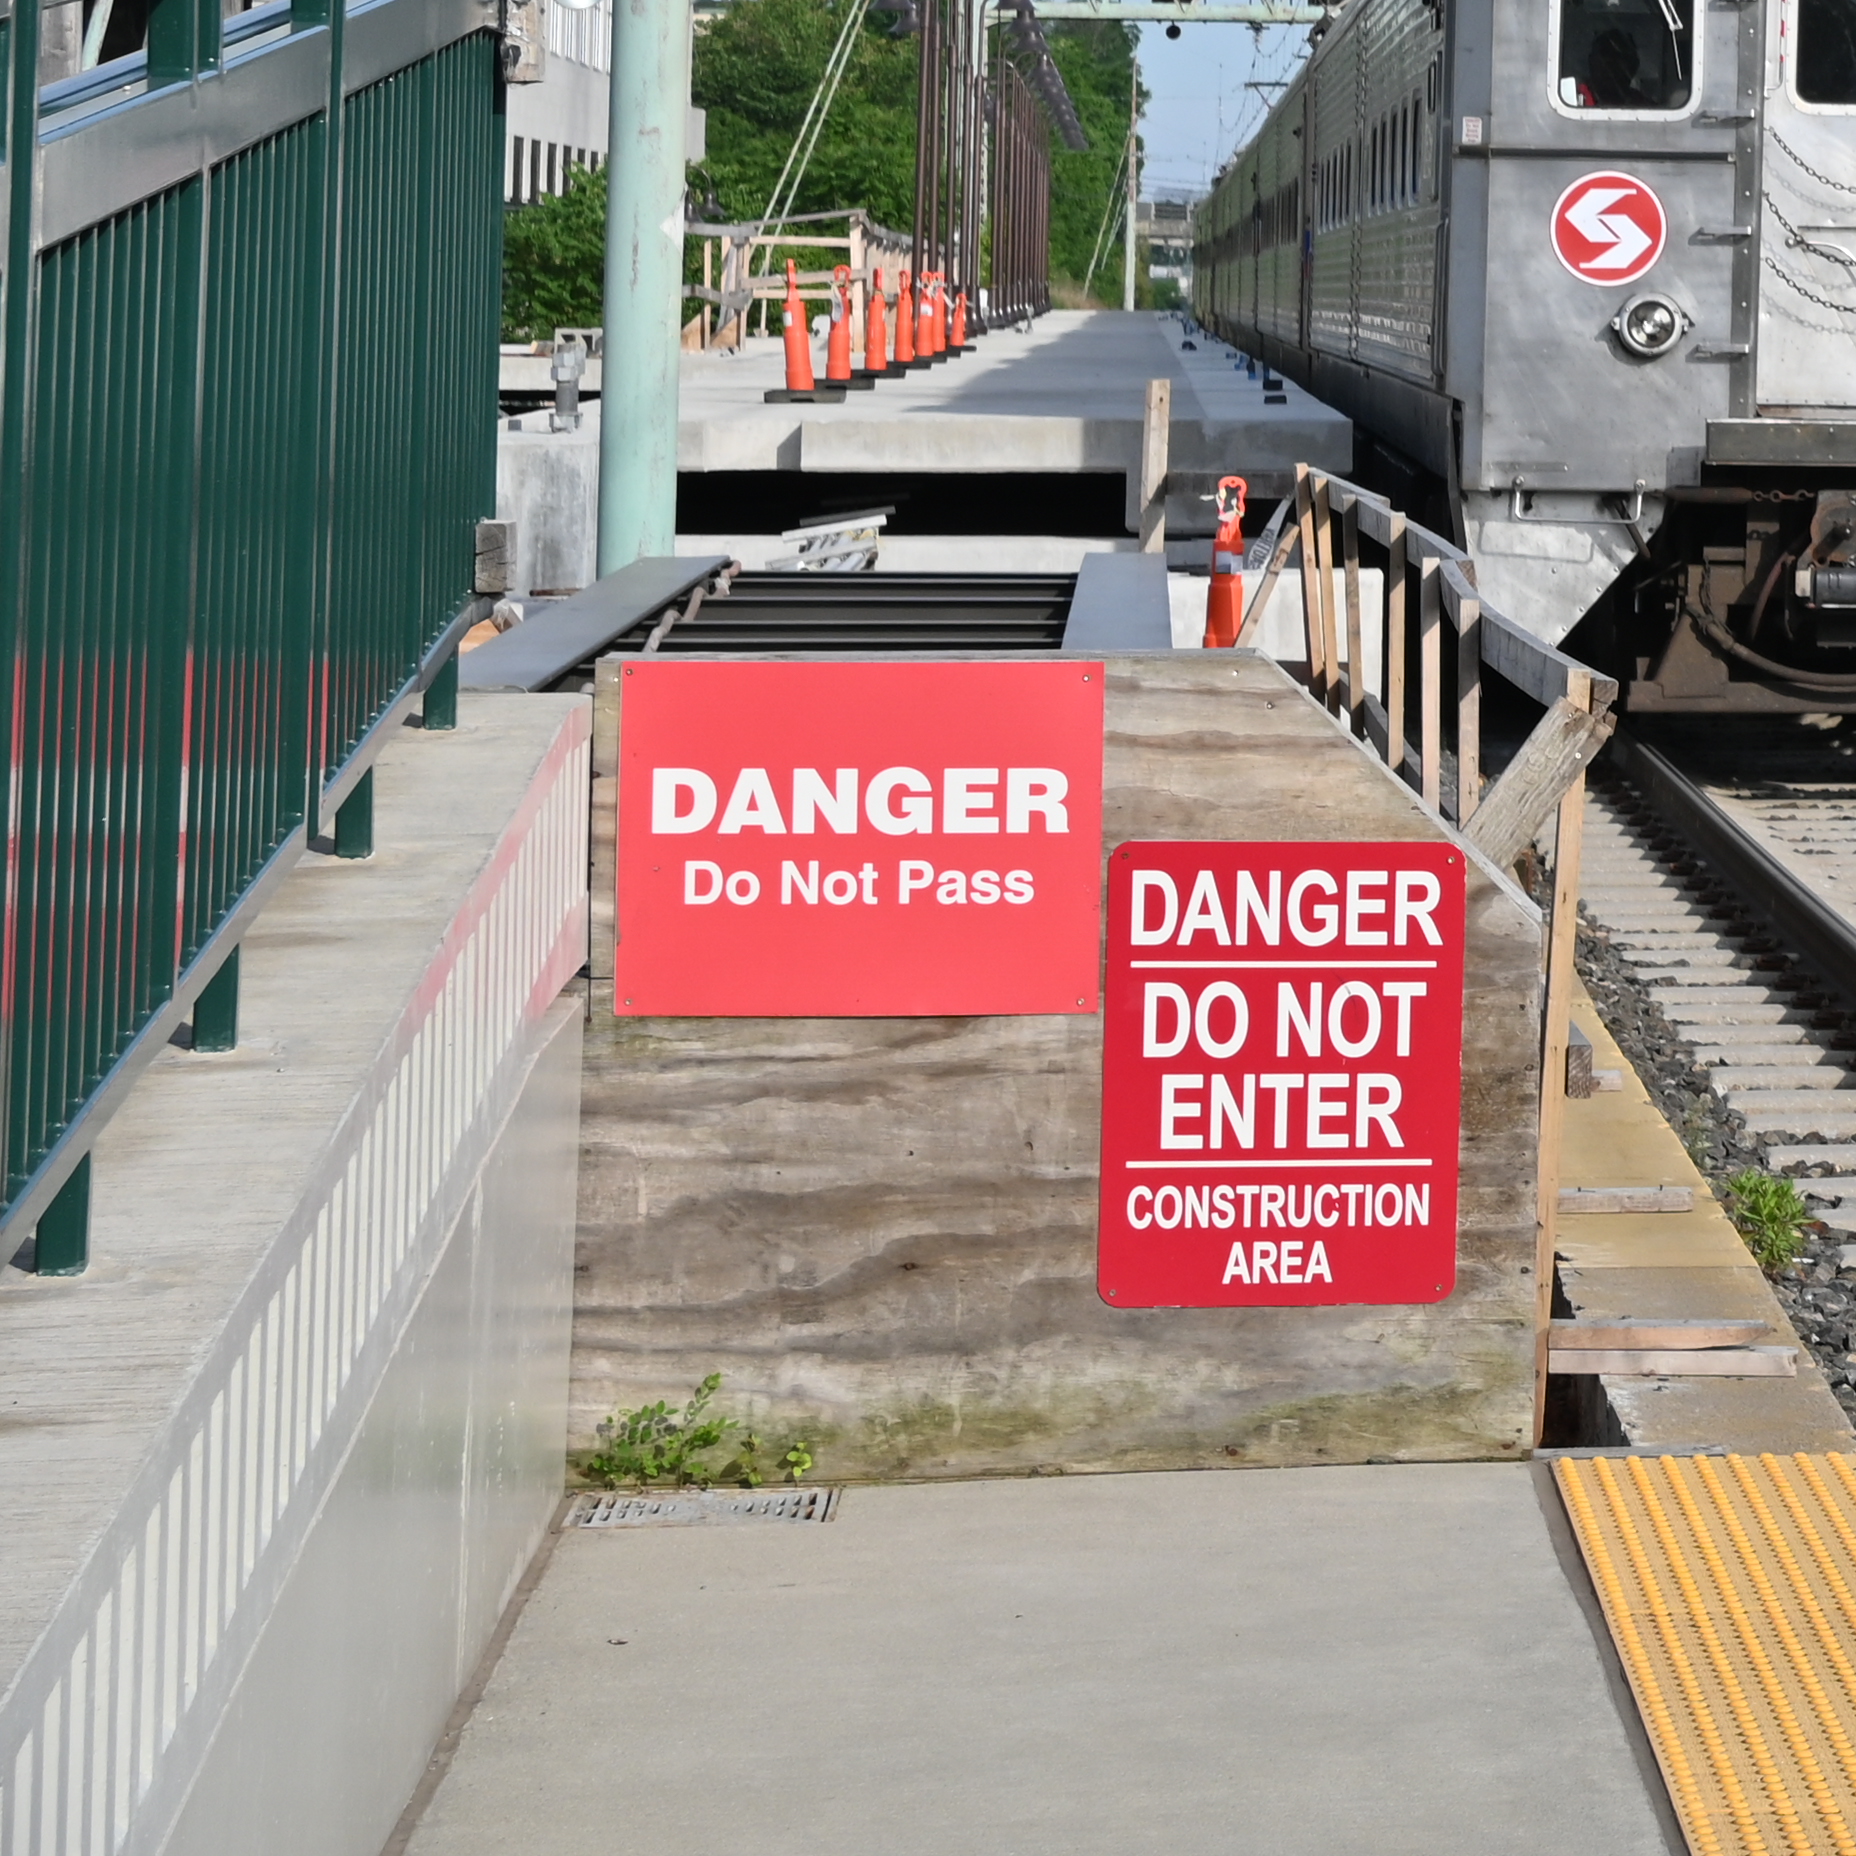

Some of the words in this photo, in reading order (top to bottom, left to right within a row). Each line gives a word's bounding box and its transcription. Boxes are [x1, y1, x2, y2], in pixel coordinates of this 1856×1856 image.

[650, 766, 1070, 835] DANGER
[683, 860, 761, 907] Do
[780, 860, 879, 907] Not
[897, 860, 1036, 907] Pass
[1129, 869, 1443, 947] DANGER
[1141, 981, 1249, 1060] DO
[1277, 980, 1428, 1058] NOT
[1158, 1072, 1405, 1150] ENTER
[1125, 1183, 1430, 1228] CONSTRUCTION
[1221, 1240, 1333, 1285] AREA
